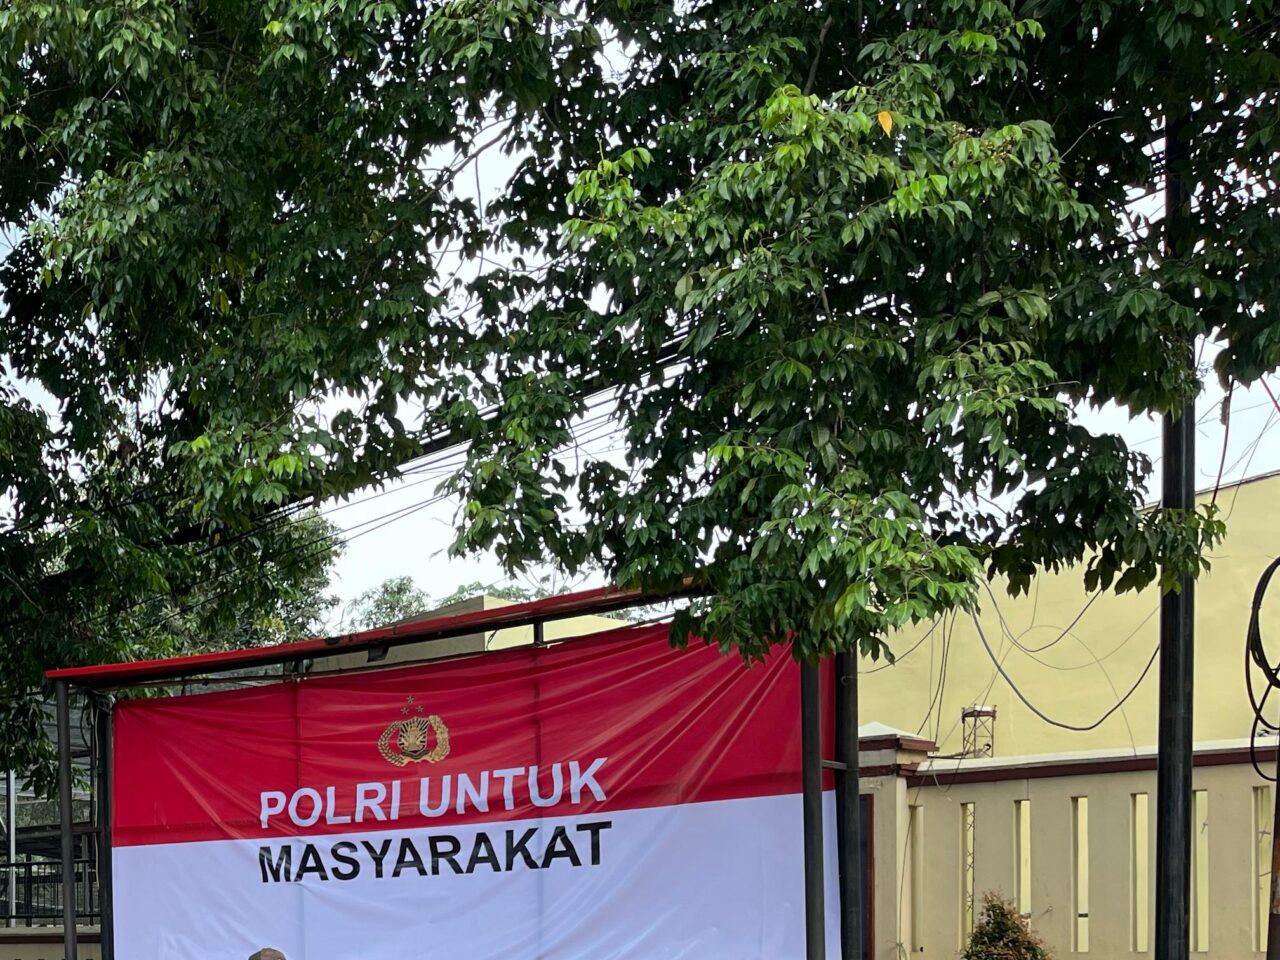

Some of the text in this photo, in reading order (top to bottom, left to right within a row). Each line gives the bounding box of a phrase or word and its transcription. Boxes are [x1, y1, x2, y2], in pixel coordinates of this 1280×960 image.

[259, 757, 609, 829] POLRI UNTUK
[259, 821, 612, 883] MASYARAKAT
